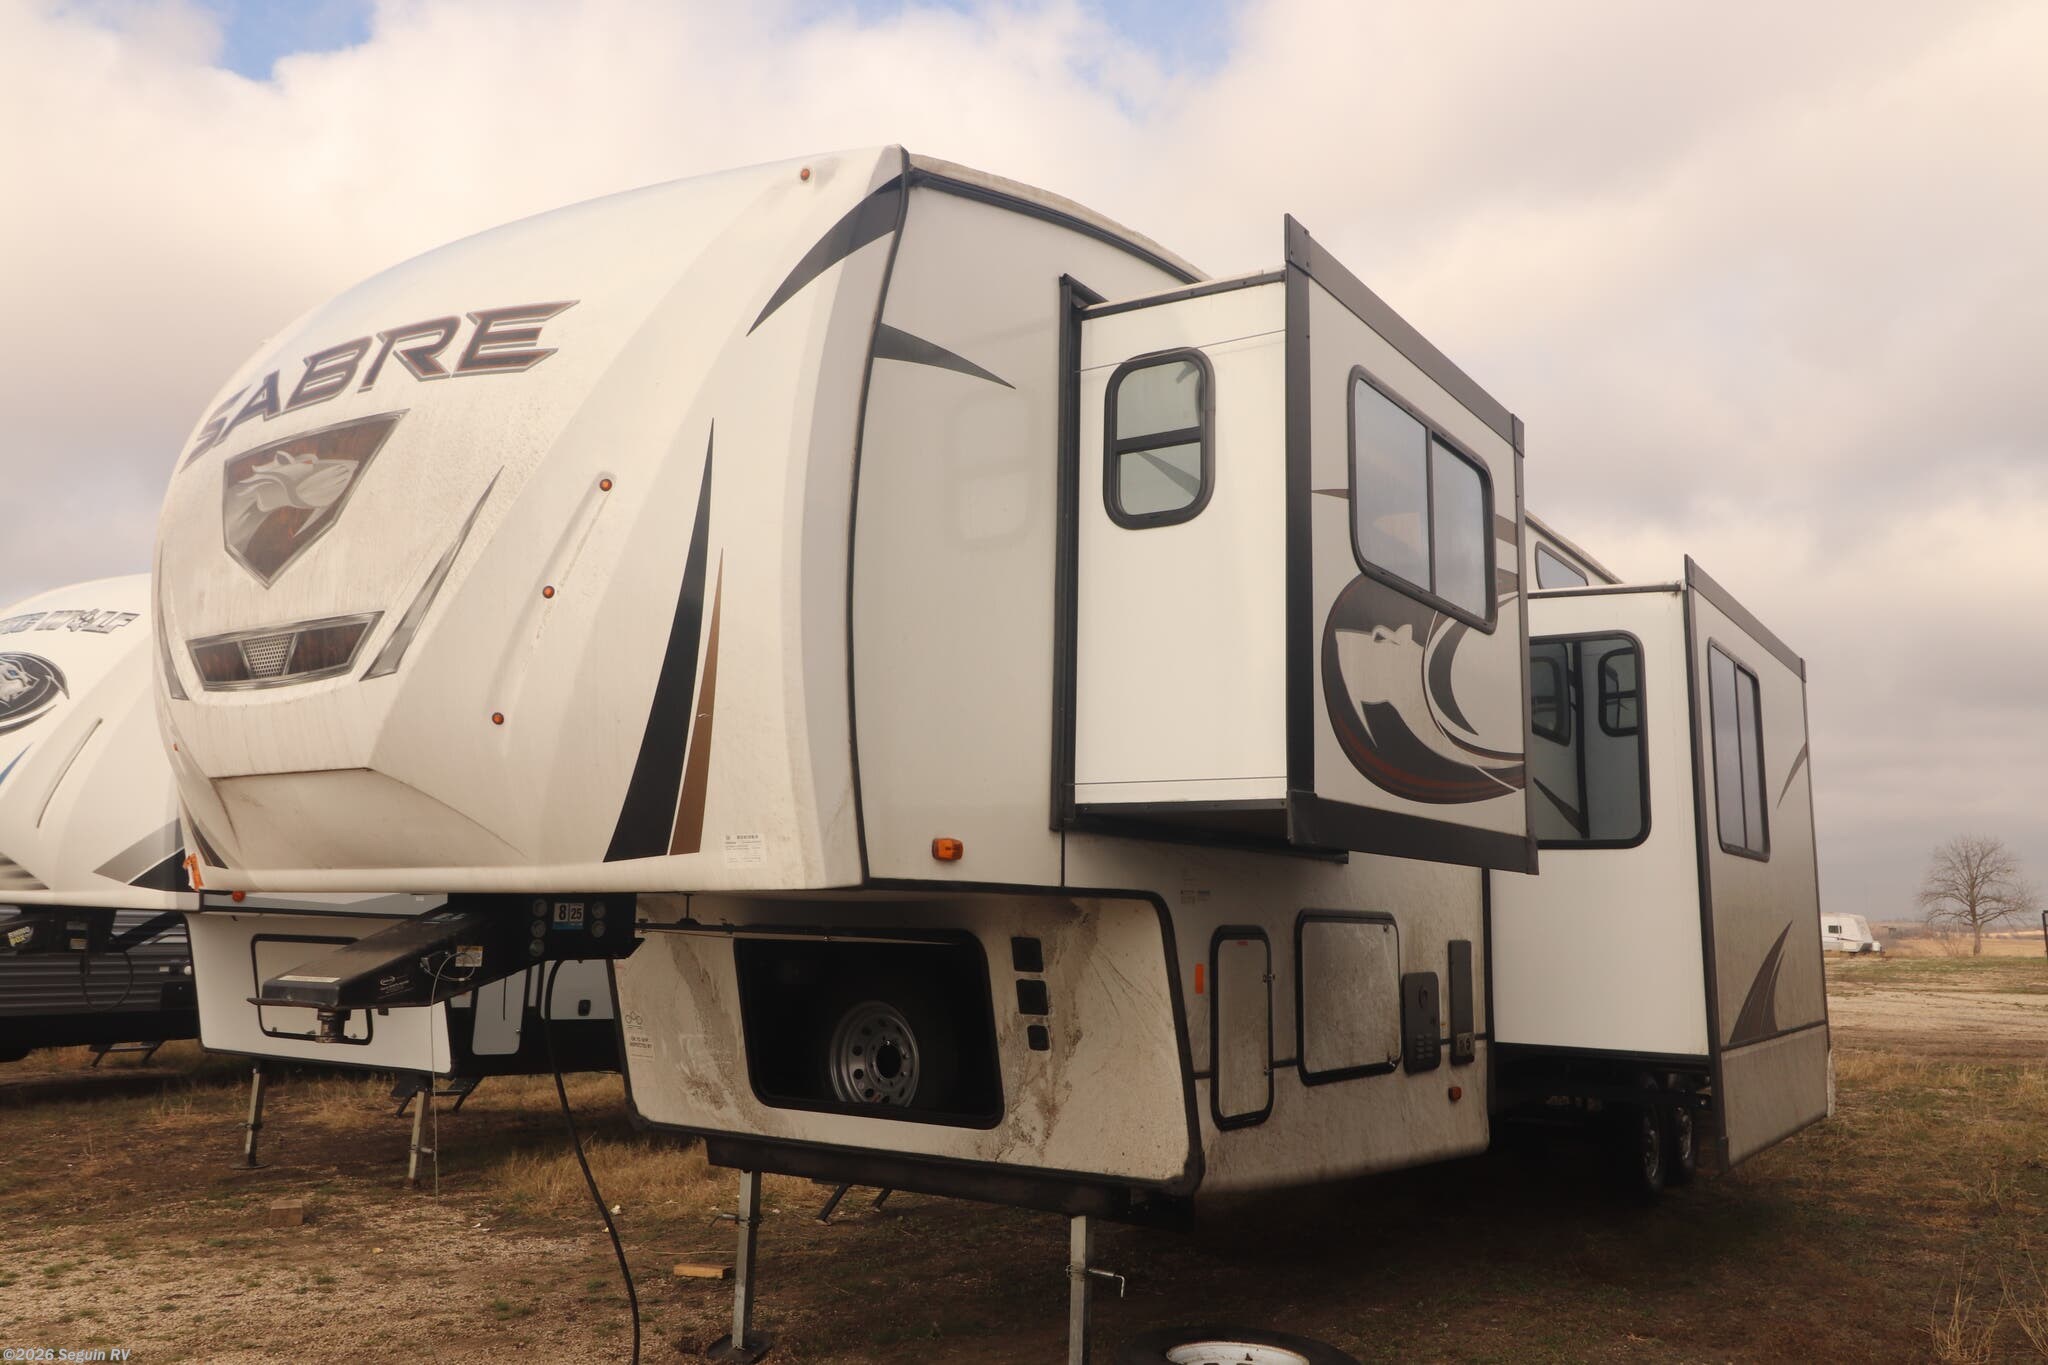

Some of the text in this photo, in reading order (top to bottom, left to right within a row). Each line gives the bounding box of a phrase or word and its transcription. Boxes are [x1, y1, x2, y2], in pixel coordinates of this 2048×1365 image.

[179, 299, 581, 474] SABRE
[558, 904, 583, 921] 8 25
